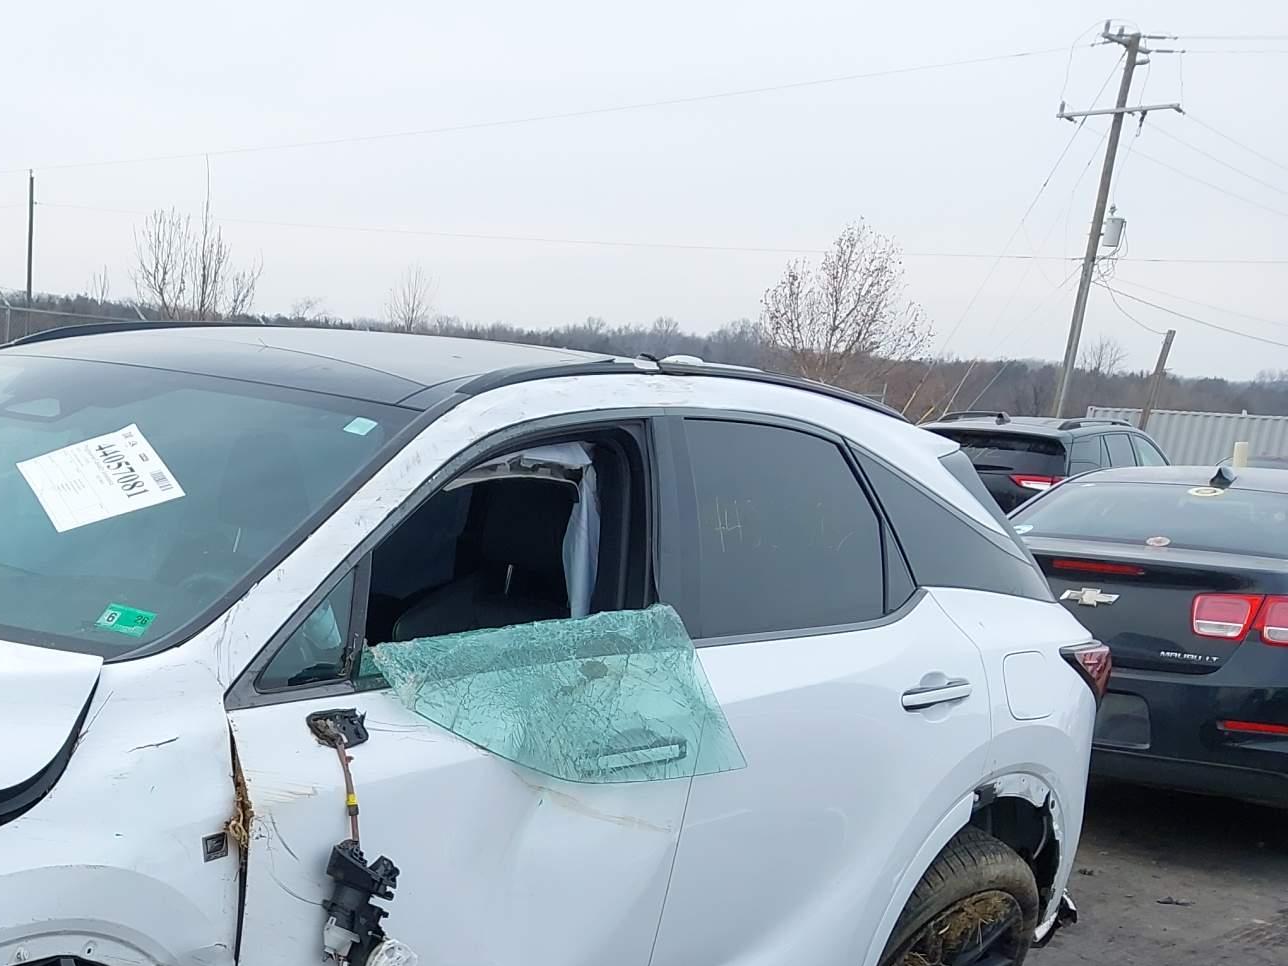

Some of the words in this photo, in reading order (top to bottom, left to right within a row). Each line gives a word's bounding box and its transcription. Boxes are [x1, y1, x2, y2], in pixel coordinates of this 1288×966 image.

[96, 445, 149, 498] 44057081
[106, 612, 117, 622] 6
[135, 615, 150, 625] 26
[1160, 651, 1202, 661] MALIBU
